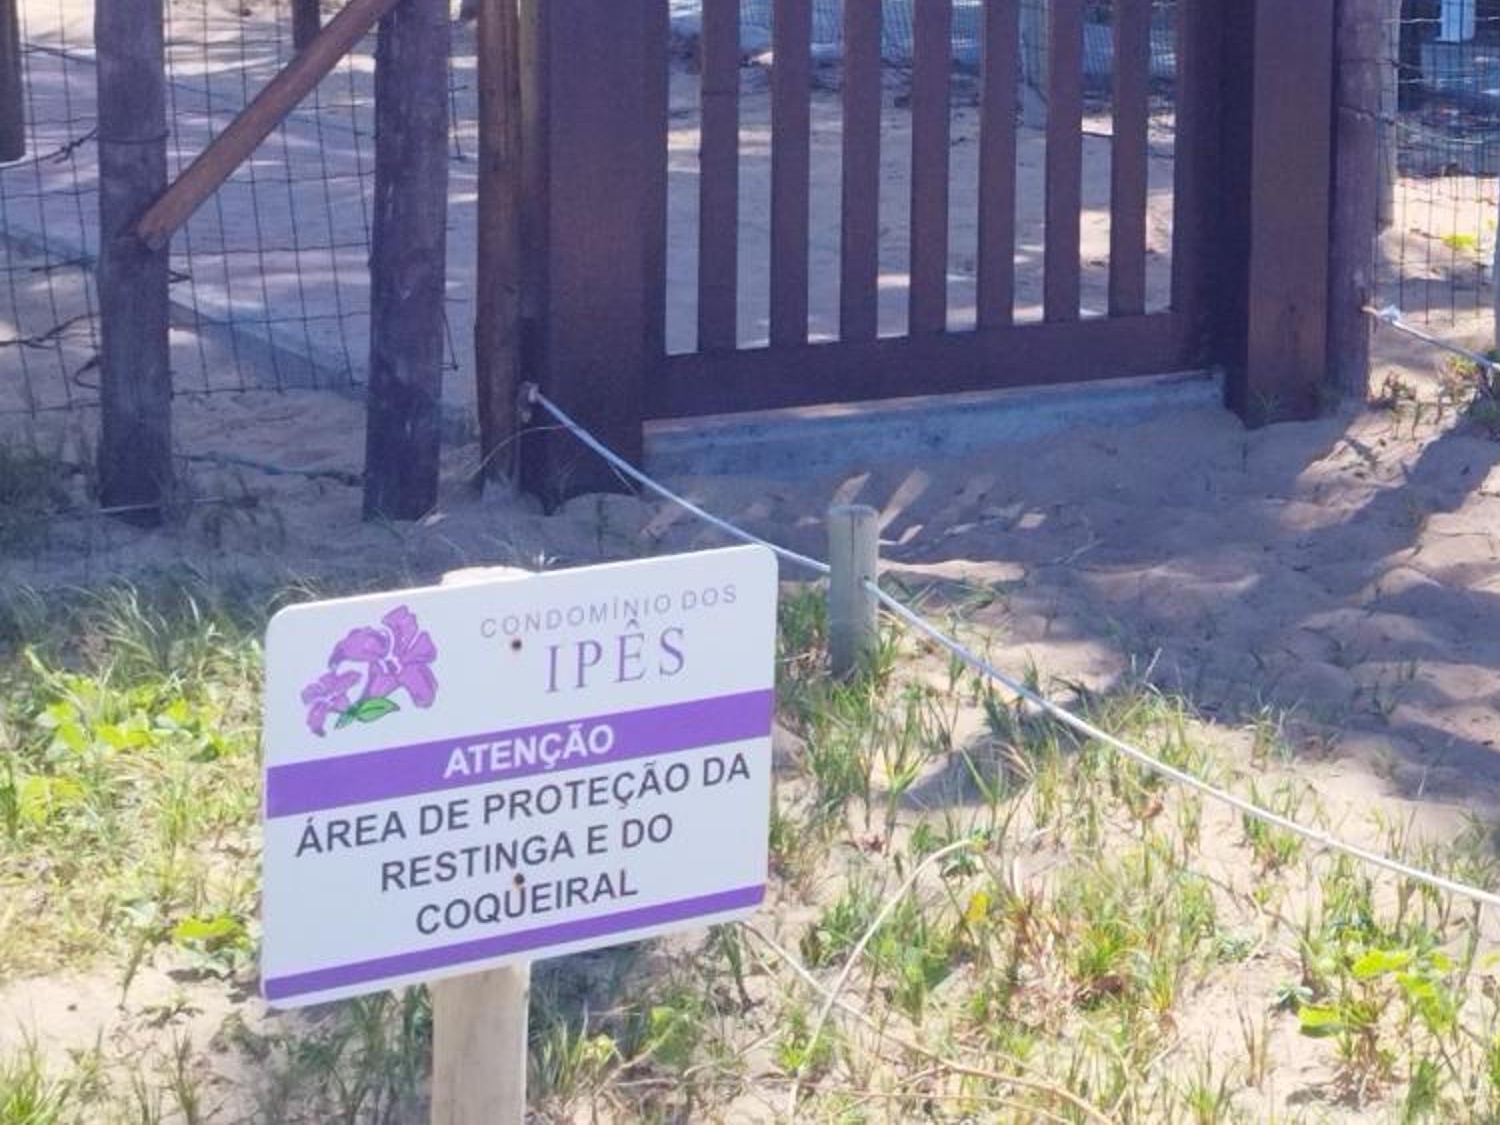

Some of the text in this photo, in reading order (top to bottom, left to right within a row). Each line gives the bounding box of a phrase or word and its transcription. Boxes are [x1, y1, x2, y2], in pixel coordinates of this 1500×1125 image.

[480, 583, 738, 639] CONDOMÍNIO DOS
[545, 618, 687, 694] IPÊS
[443, 723, 614, 779] ATENÇÃO
[295, 752, 751, 858] ÁREA DE PROTEÇÃO DA
[381, 813, 673, 892] RESTINGA E DO
[416, 869, 639, 935] COQUEIRAL
